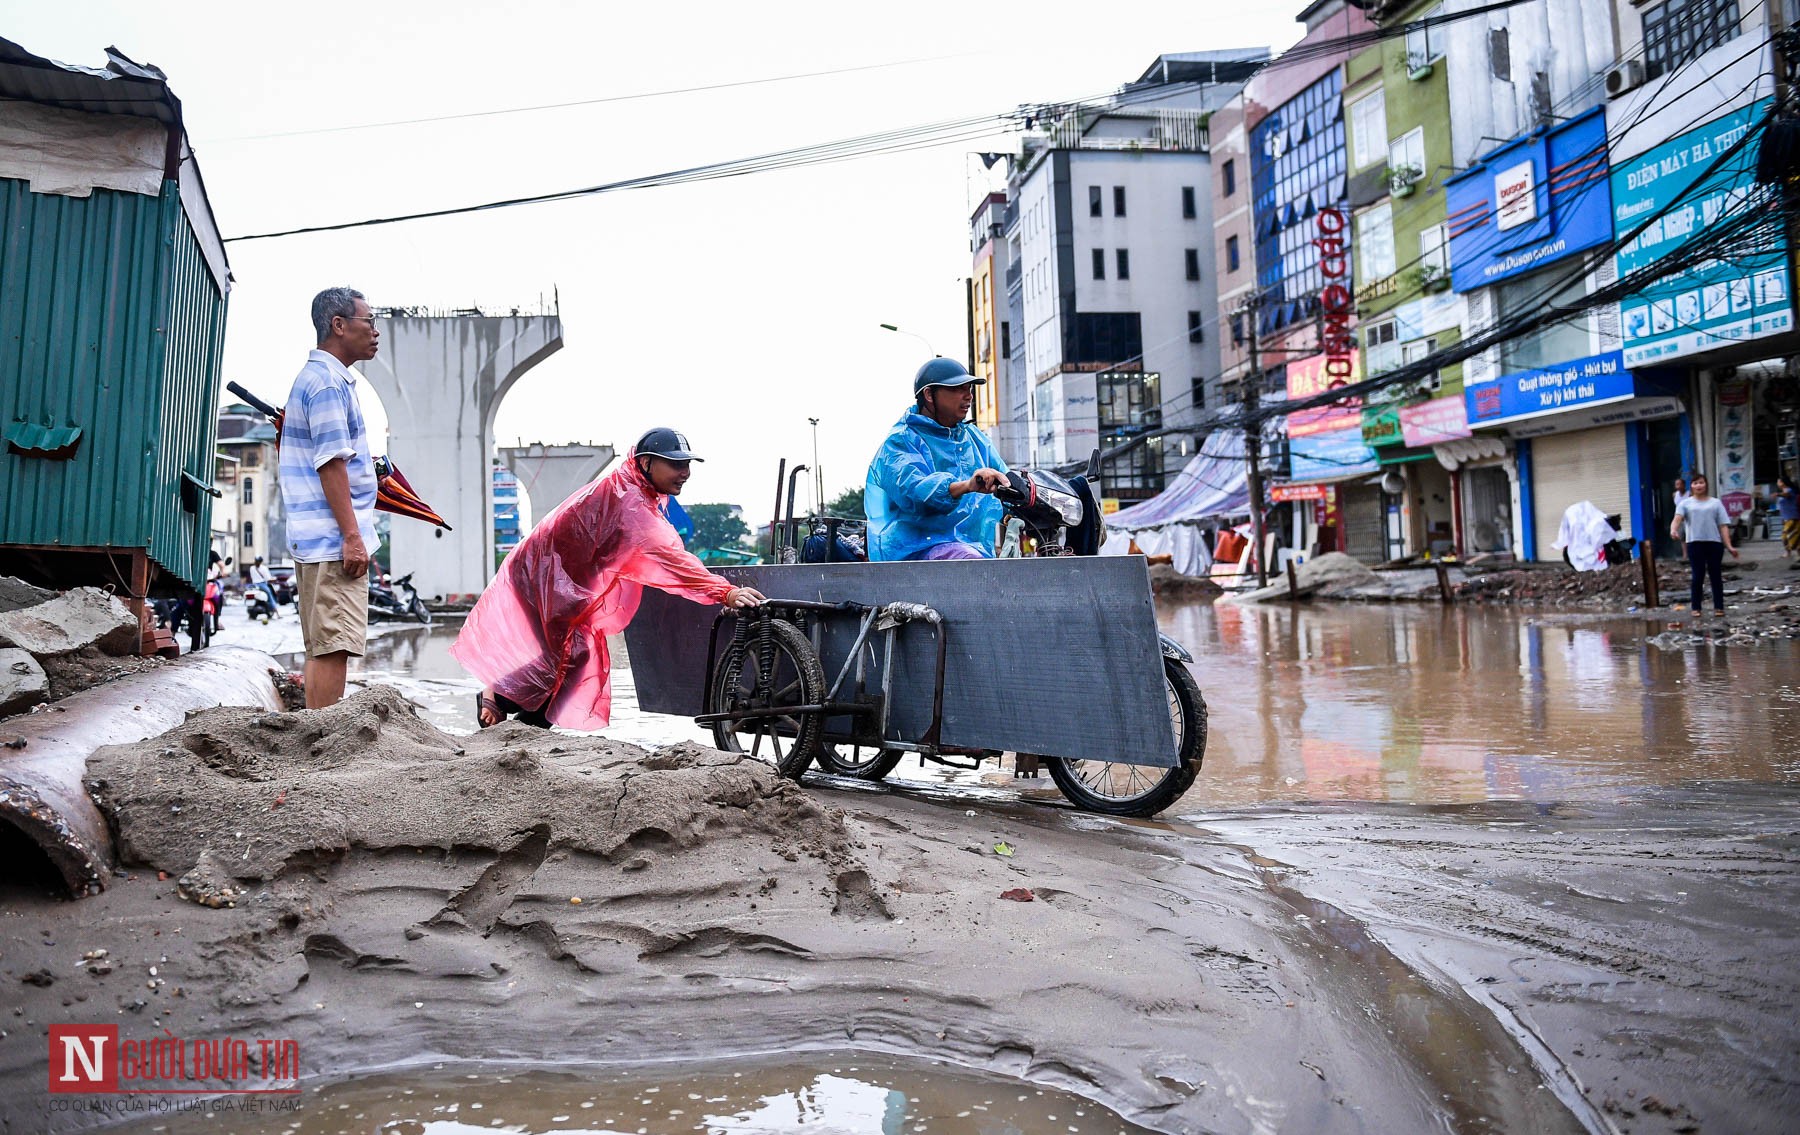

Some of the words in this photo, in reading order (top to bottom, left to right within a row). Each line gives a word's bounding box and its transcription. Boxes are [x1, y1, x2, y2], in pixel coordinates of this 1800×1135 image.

[1627, 162, 1658, 190] ĐIỆN
[1660, 149, 1689, 176] MÁY
[1501, 180, 1527, 198] DUSON
[1518, 376, 1538, 392] Quạt
[1539, 372, 1563, 387] thông
[1585, 361, 1600, 377] Hút
[1602, 358, 1617, 376] bụi
